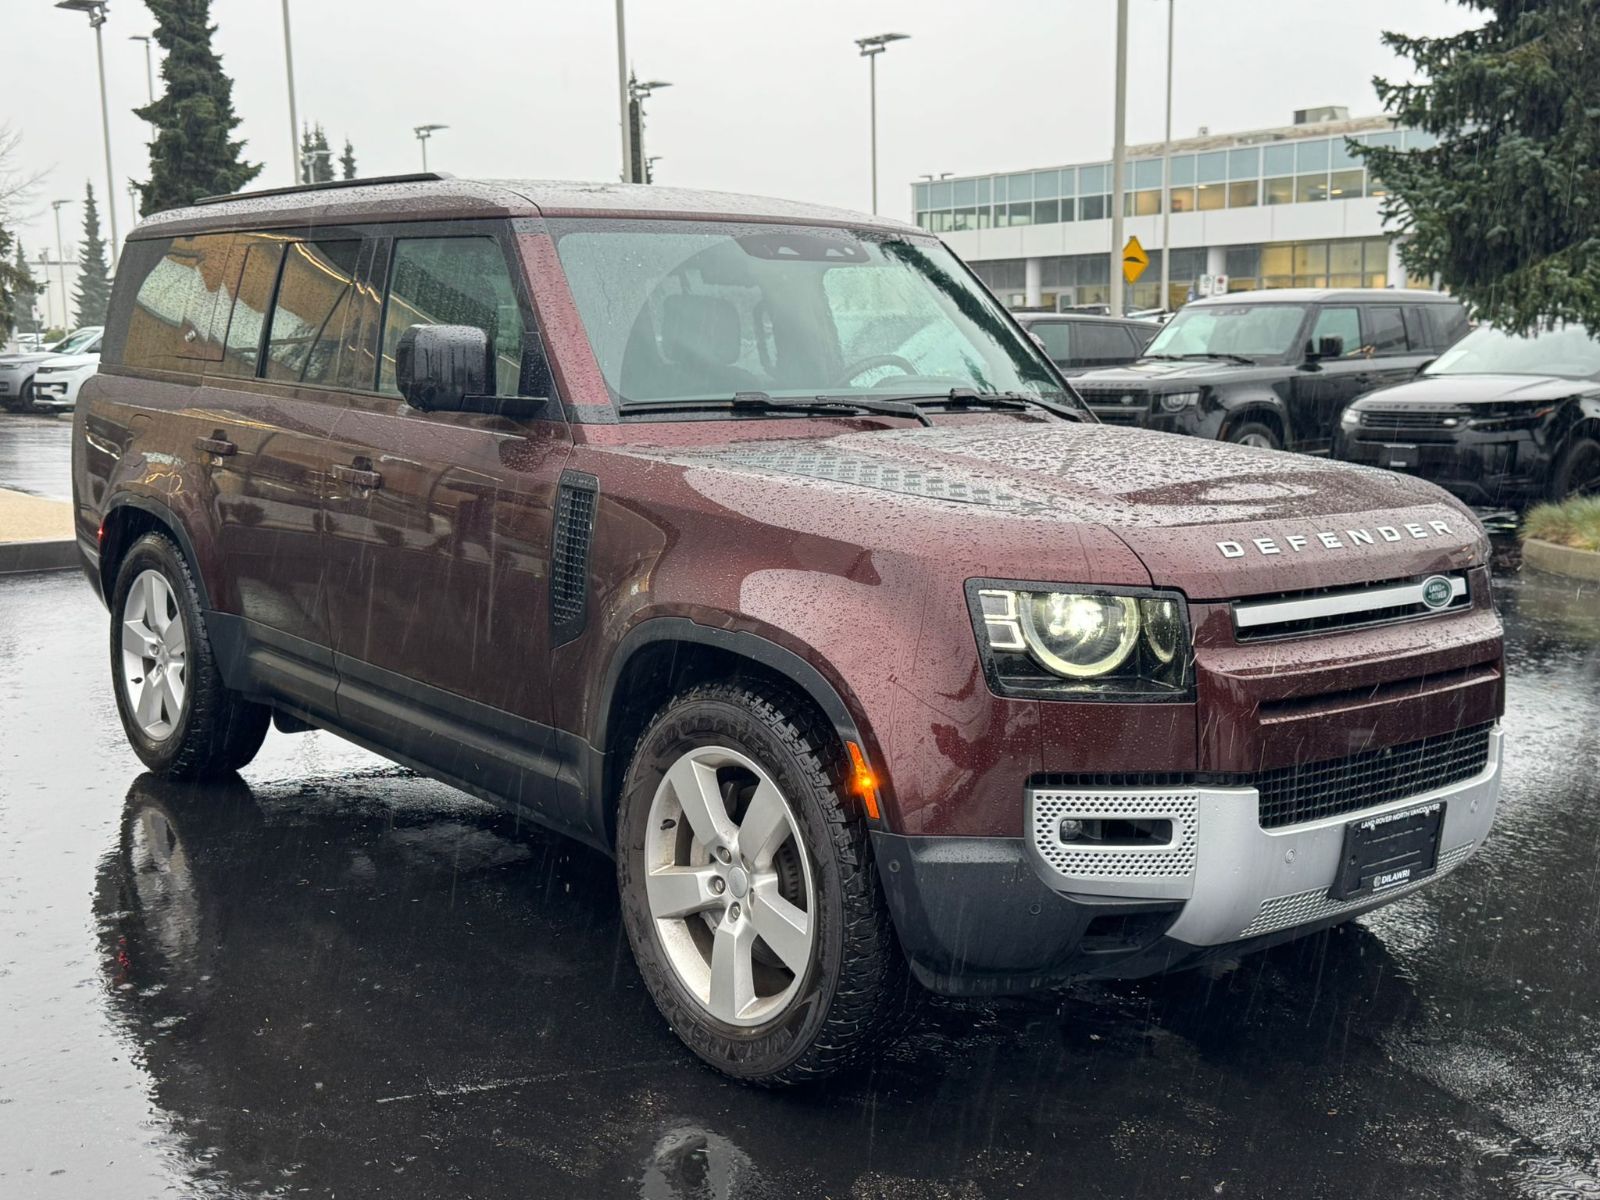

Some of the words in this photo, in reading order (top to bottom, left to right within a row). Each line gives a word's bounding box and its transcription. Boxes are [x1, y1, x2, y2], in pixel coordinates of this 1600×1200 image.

[1216, 520, 1453, 558] DEFENDER
[1376, 814, 1393, 825] ROVER
[1393, 810, 1411, 821] NORTH
[1381, 868, 1411, 884] DILAWRI
